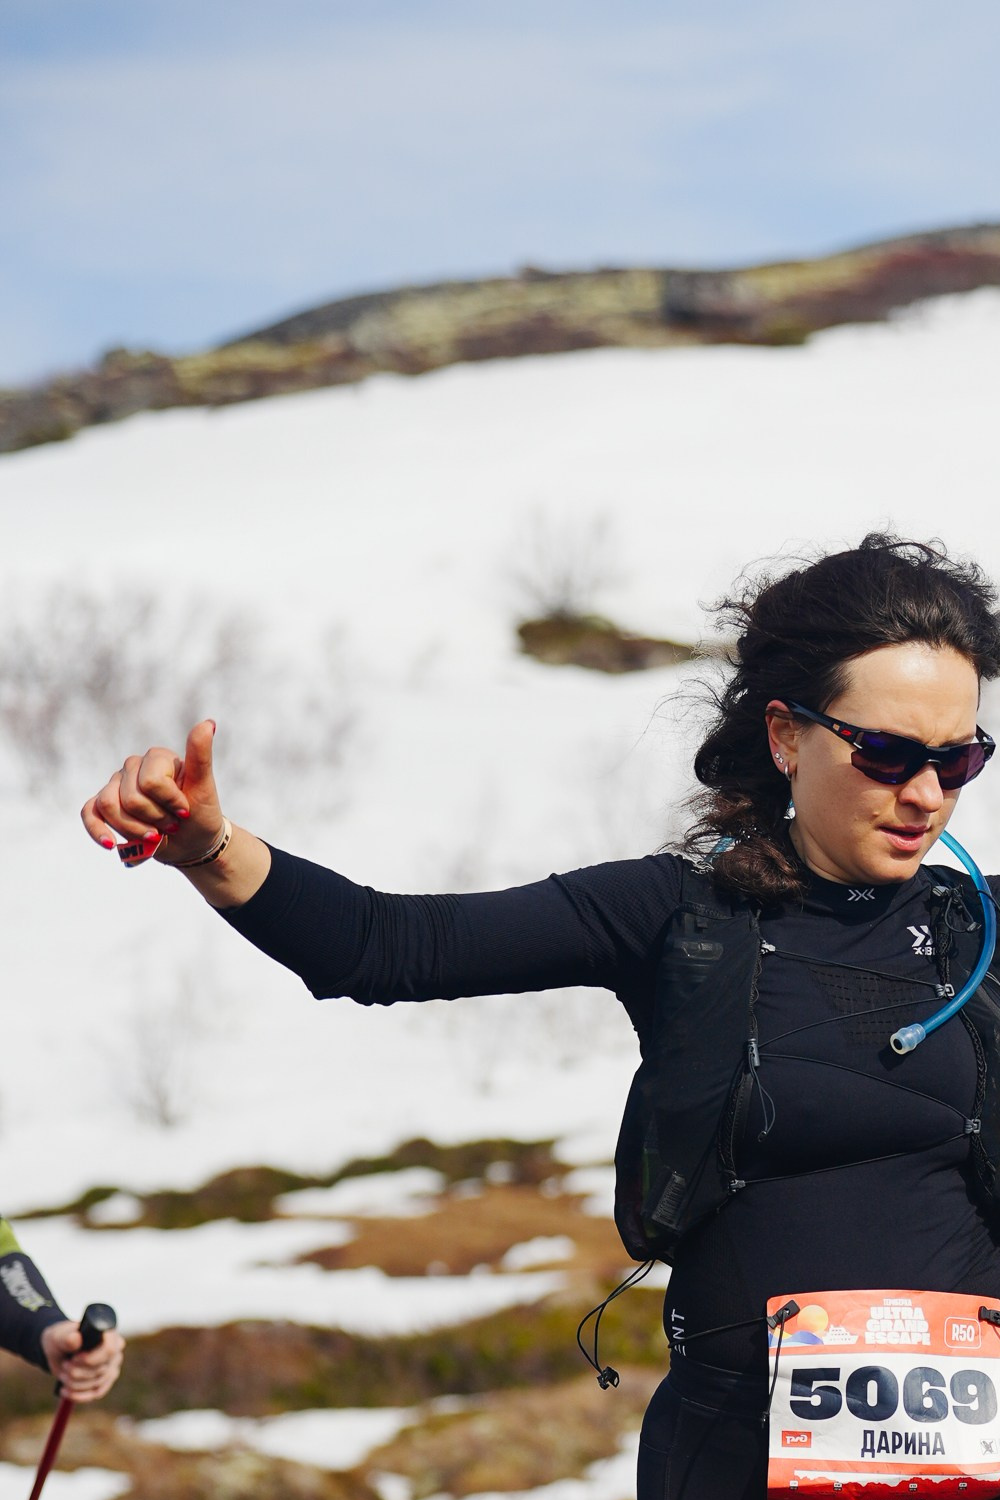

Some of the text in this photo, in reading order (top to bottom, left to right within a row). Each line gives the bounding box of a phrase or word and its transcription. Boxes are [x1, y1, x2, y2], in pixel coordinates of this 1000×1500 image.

[870, 1307, 925, 1320] ULTRA
[866, 1319, 929, 1332] GRAND
[951, 1323, 975, 1342] R50
[864, 1331, 931, 1345] ESCAPE
[789, 1365, 998, 1425] 5069
[860, 1429, 946, 1458] ДАРИНА
